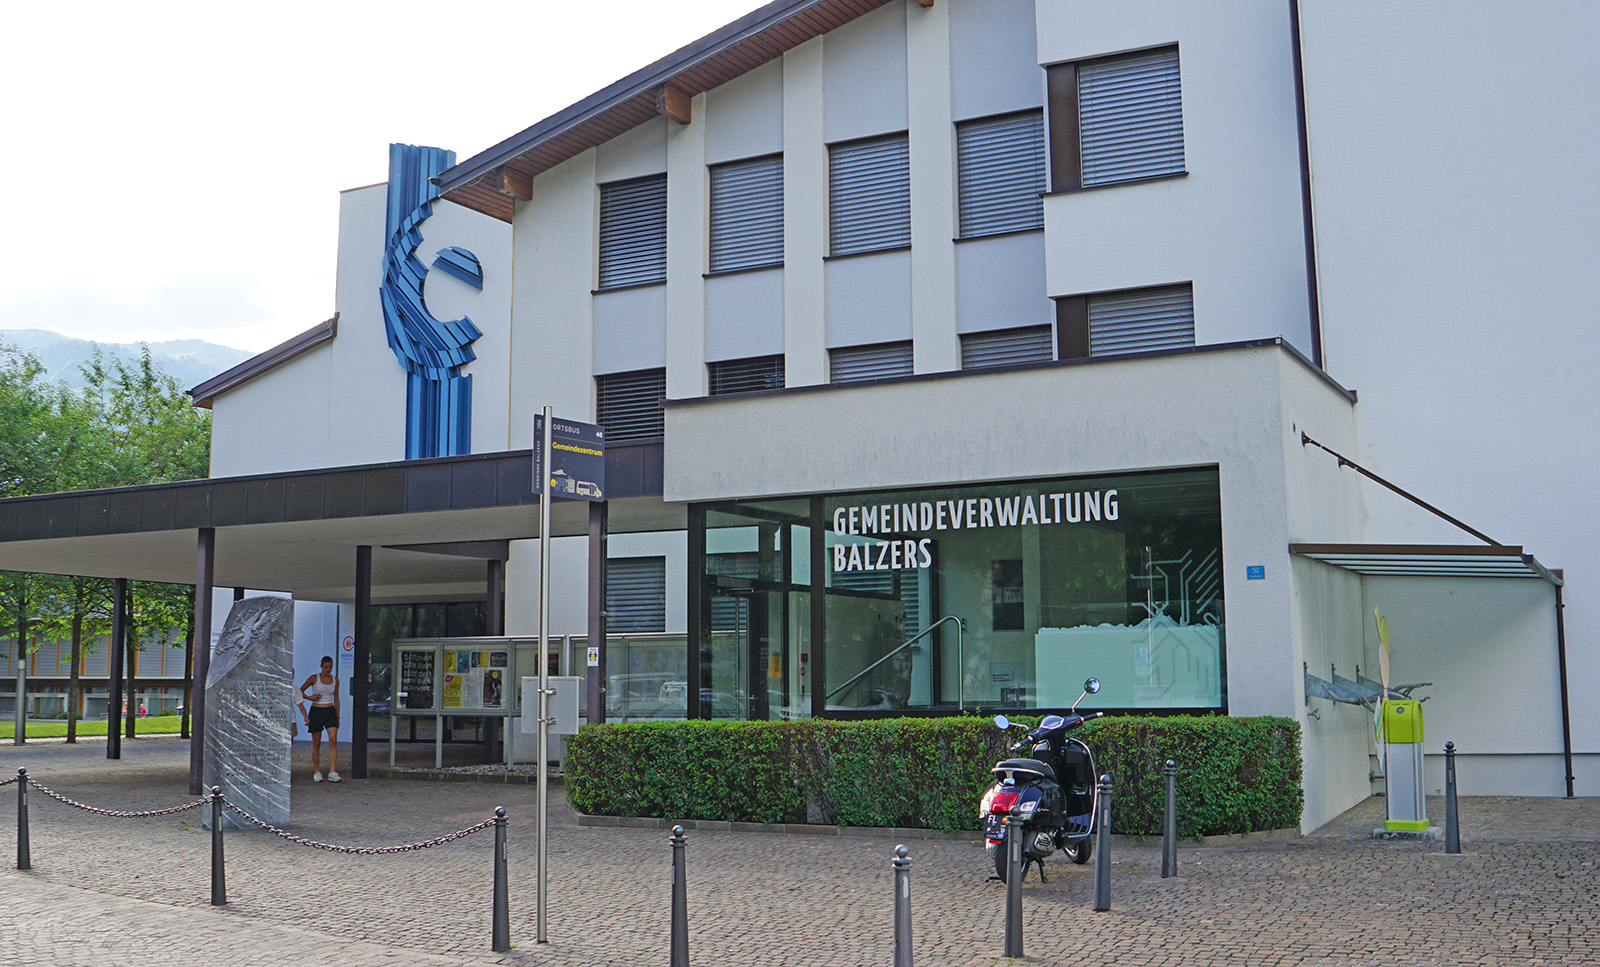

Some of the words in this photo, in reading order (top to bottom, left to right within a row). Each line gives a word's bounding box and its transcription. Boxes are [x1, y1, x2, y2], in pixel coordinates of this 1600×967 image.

[552, 423, 581, 434] ORTSBUS
[552, 441, 603, 457] Gemeindezentrum
[832, 489, 1120, 536] GEMEINDEVERWALTUNG
[833, 538, 933, 572] BALZERS
